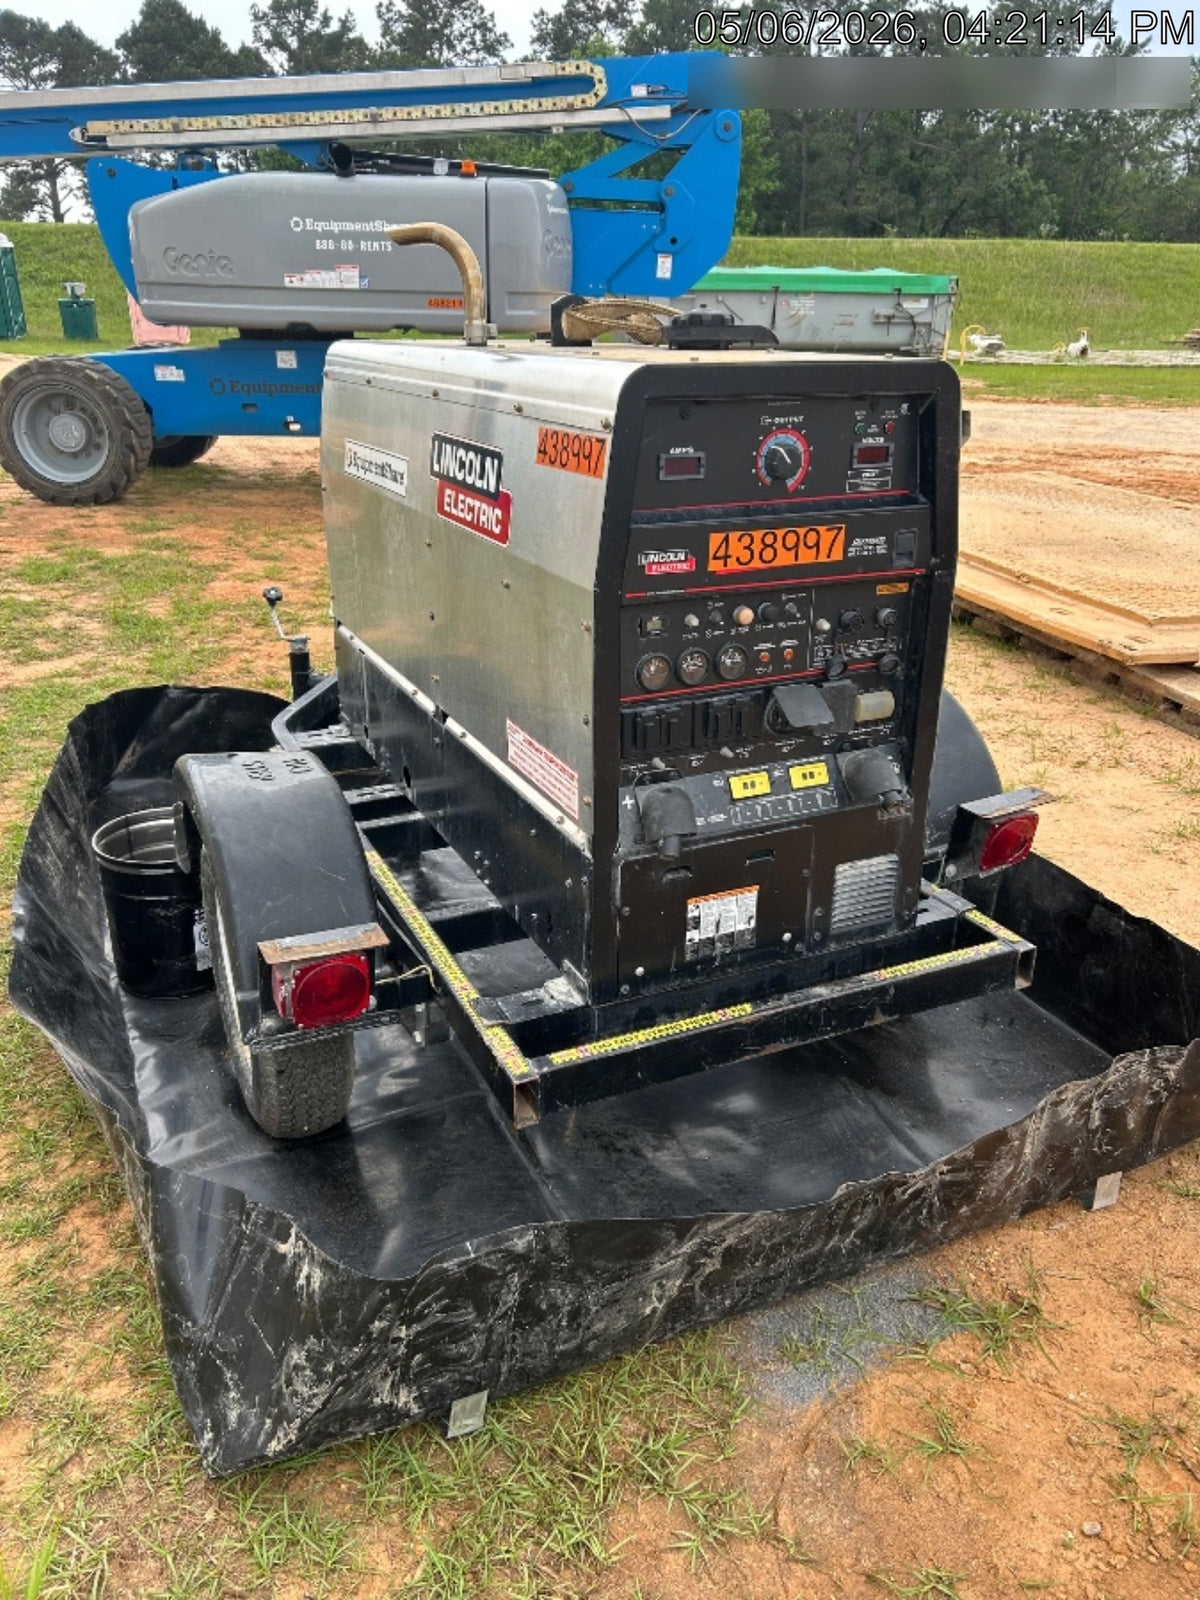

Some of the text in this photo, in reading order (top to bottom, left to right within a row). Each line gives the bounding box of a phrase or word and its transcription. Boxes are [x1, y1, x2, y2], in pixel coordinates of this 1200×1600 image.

[433, 440, 499, 494] LINCOLN
[538, 428, 607, 477] 438997
[443, 488, 502, 535] ELECTRIC
[641, 552, 686, 566] LINCOLN
[712, 525, 844, 568] 438997
